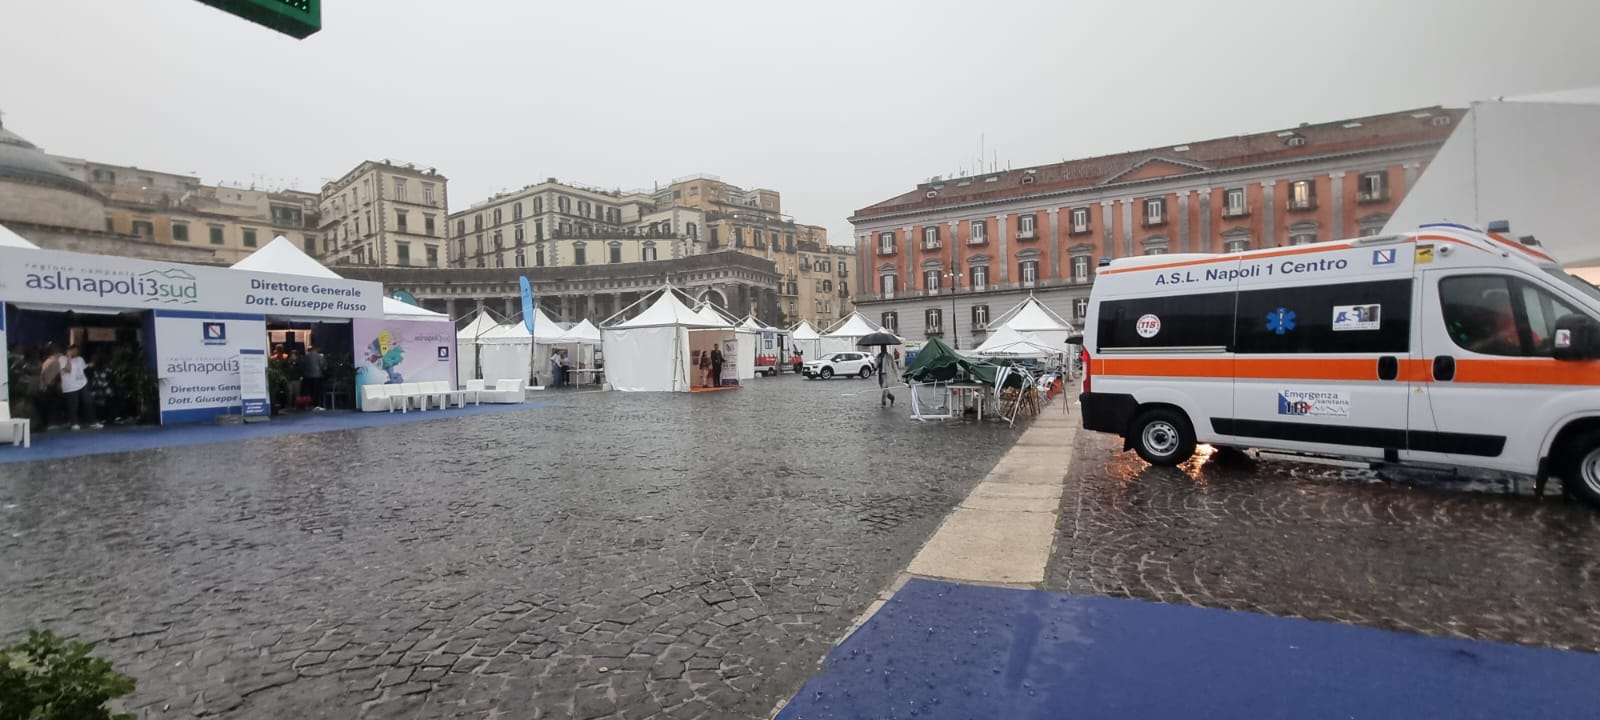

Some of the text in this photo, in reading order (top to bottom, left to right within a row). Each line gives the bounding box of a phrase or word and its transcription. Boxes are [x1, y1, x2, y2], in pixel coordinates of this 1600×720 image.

[1155, 258, 1348, 286] A.S.L. Napoli 1 Centro
[25, 271, 198, 299] aslnapoli3sud
[250, 279, 361, 297] Direttore Generale
[245, 294, 366, 311] Dott. Giuseppe Russo
[170, 384, 216, 393] Direttore
[1284, 389, 1339, 400] Emergenza
[168, 395, 239, 405] Dott. Giuseppe
